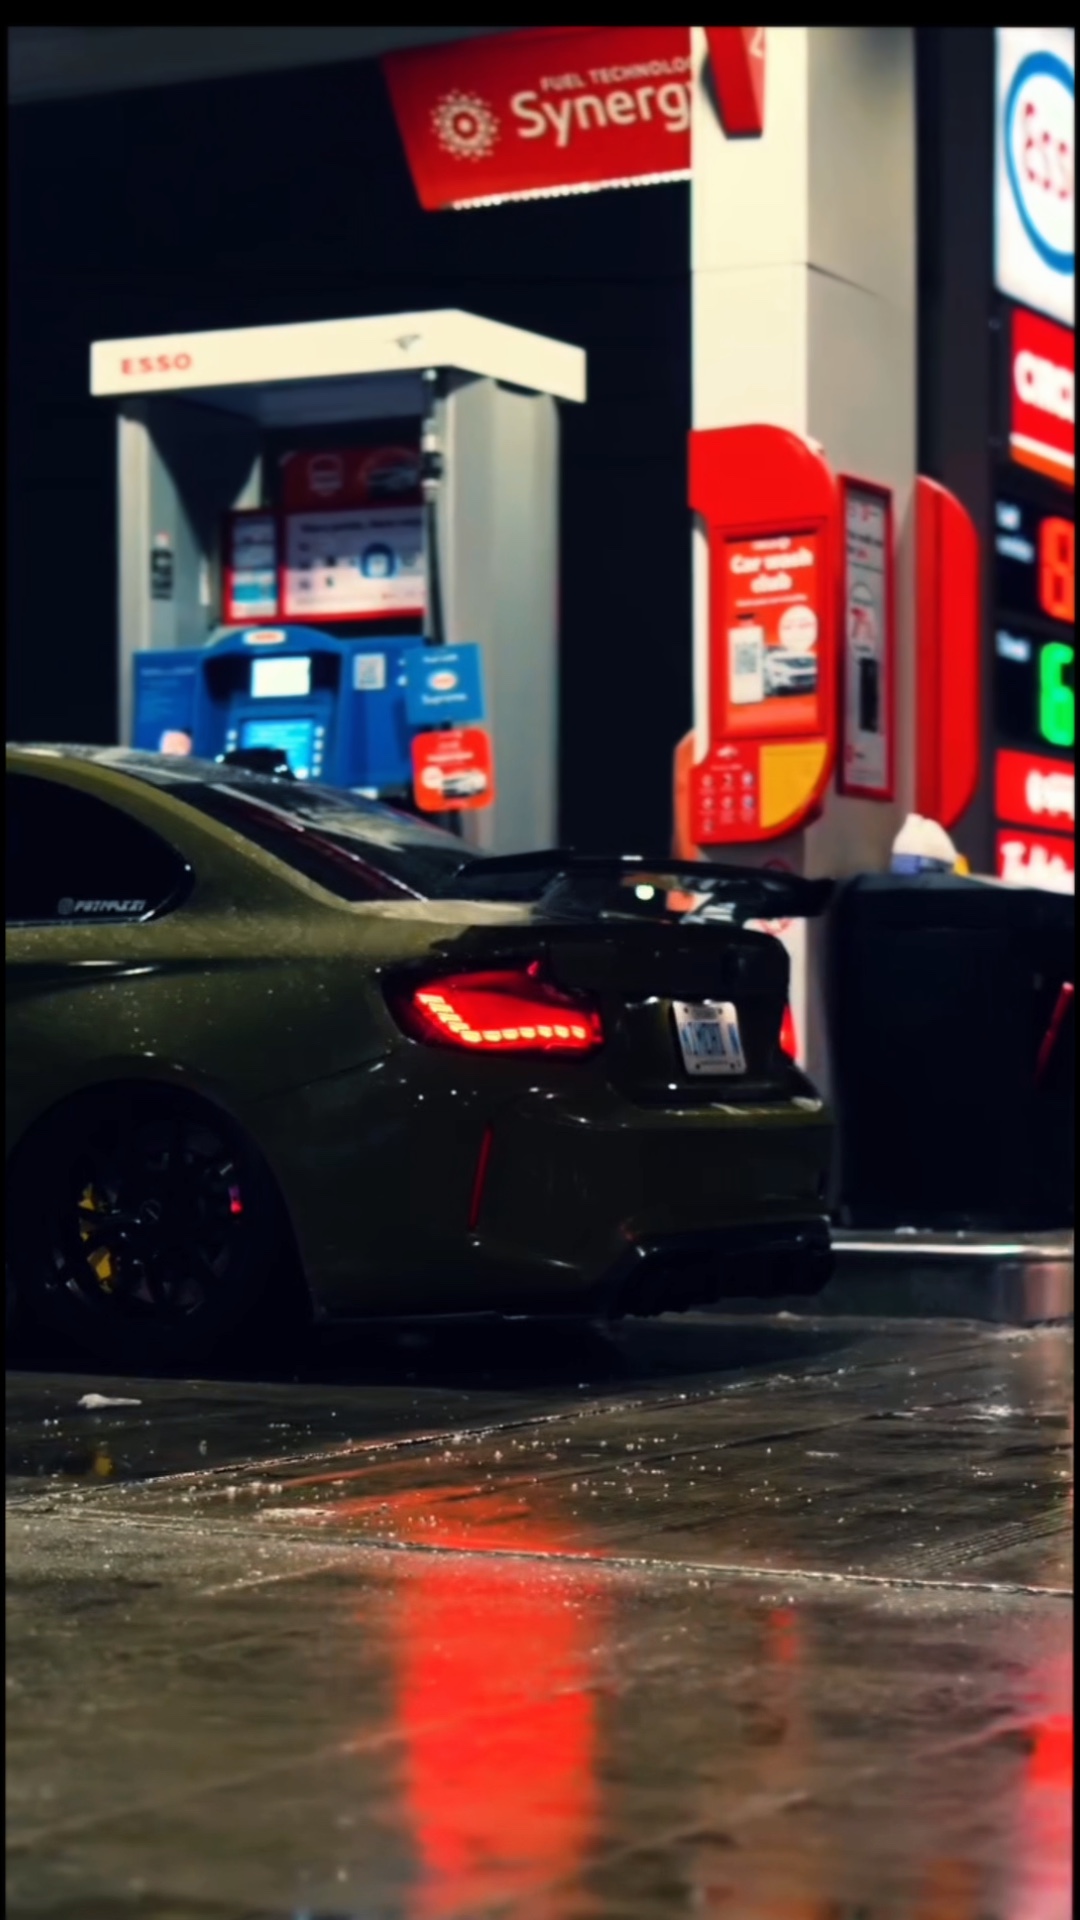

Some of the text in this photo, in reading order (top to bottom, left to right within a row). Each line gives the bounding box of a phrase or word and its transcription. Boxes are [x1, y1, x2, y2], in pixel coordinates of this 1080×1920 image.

[539, 72, 586, 92] FUEL
[511, 81, 691, 148] Synerg
[121, 351, 192, 375] ESSO
[730, 554, 761, 575] Car
